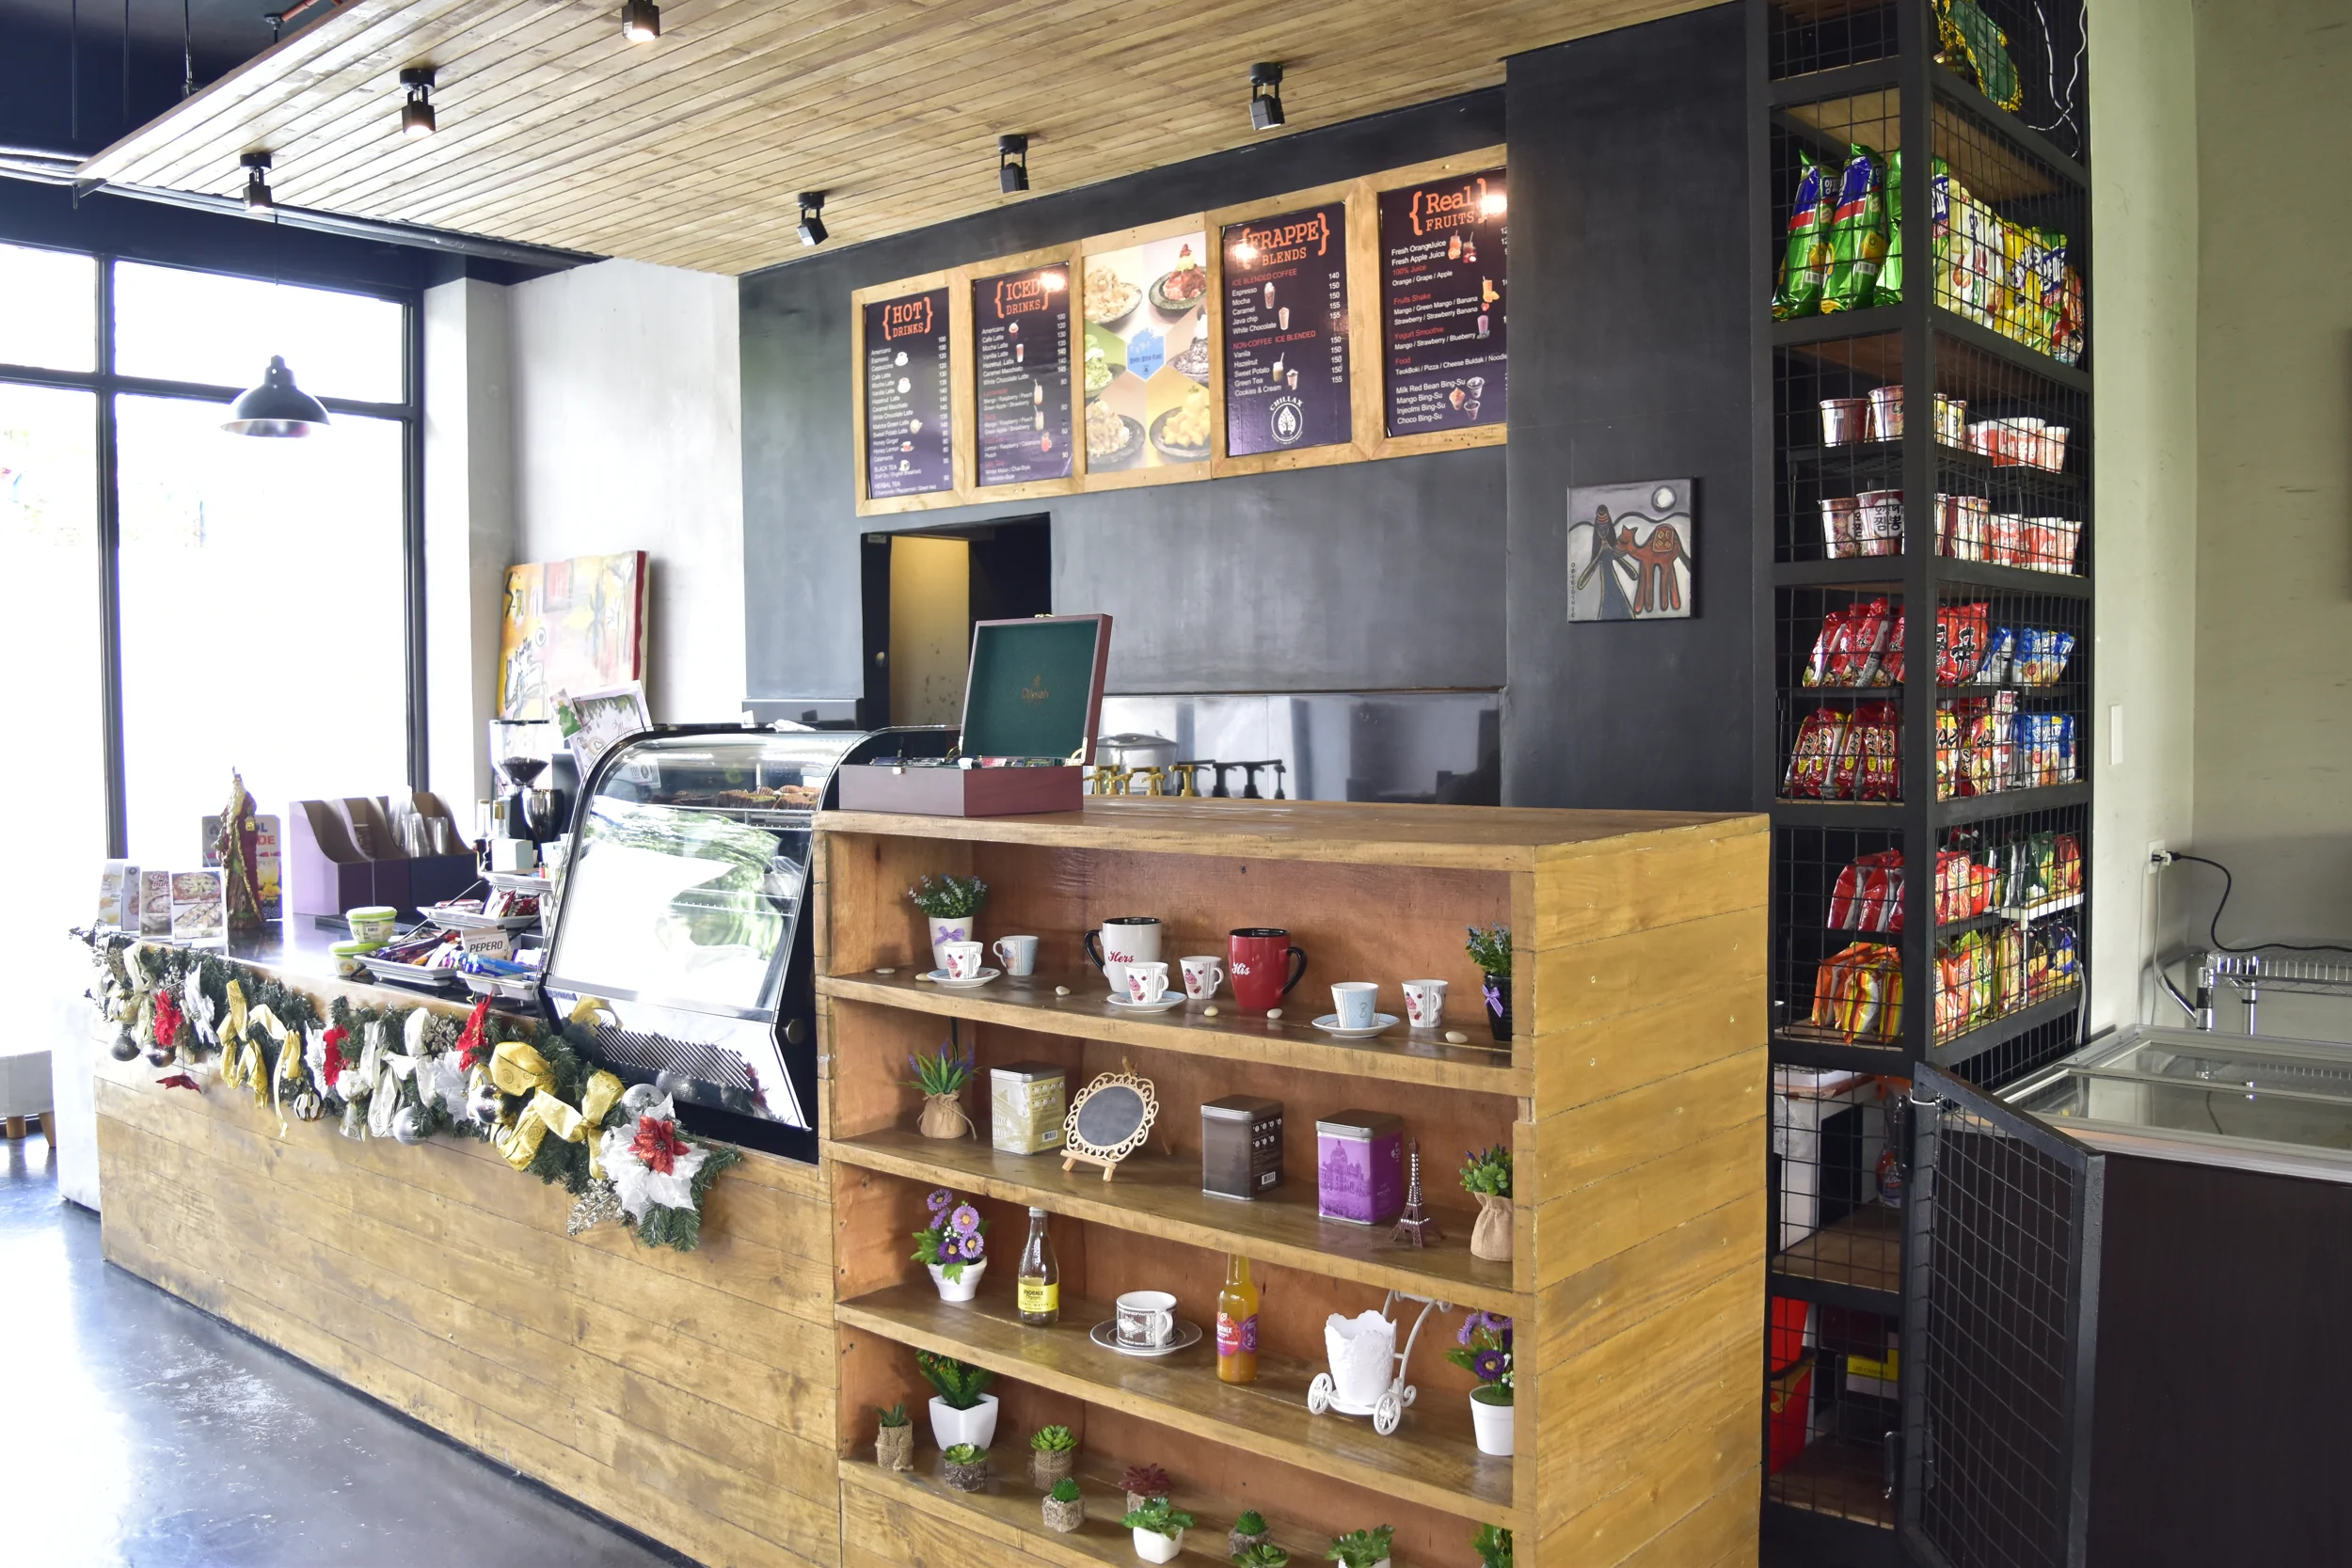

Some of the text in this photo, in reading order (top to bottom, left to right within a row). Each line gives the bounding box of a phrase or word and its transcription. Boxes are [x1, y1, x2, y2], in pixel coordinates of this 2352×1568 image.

[1425, 185, 1474, 214] Real
[1425, 210, 1475, 231] FRUITS
[1248, 220, 1320, 250] FRAPPE
[1262, 246, 1307, 266] BLENDS
[1408, 254, 1427, 262] Apple
[1243, 274, 1271, 284] BLENDED
[1273, 268, 1297, 278] COFFEE
[1006, 278, 1041, 301] ICED
[1232, 288, 1257, 296] Espresso
[893, 301, 923, 324] HOT
[1006, 299, 1041, 315] DRINKS
[1232, 307, 1255, 315] Caramel
[1426, 311, 1455, 320] Strawberry
[893, 323, 924, 338] DRINKS
[1249, 323, 1277, 331] Chocolate
[1395, 327, 1444, 340] Yogurt Smoothie
[1233, 338, 1272, 349] NON-COFFEE
[1286, 330, 1315, 341] BLENDED
[1417, 338, 1445, 346] Strawberry
[1441, 378, 1465, 388] Bing-Su
[1269, 395, 1304, 411] CHILLAX
[1419, 392, 1442, 401] Bing-Su
[1397, 402, 1445, 415] Injeolmi Bing-Su
[1418, 413, 1442, 421] Bing-Su
[469, 941, 503, 954] PEPERO
[1107, 950, 1135, 963] Hers
[1231, 962, 1251, 975] His
